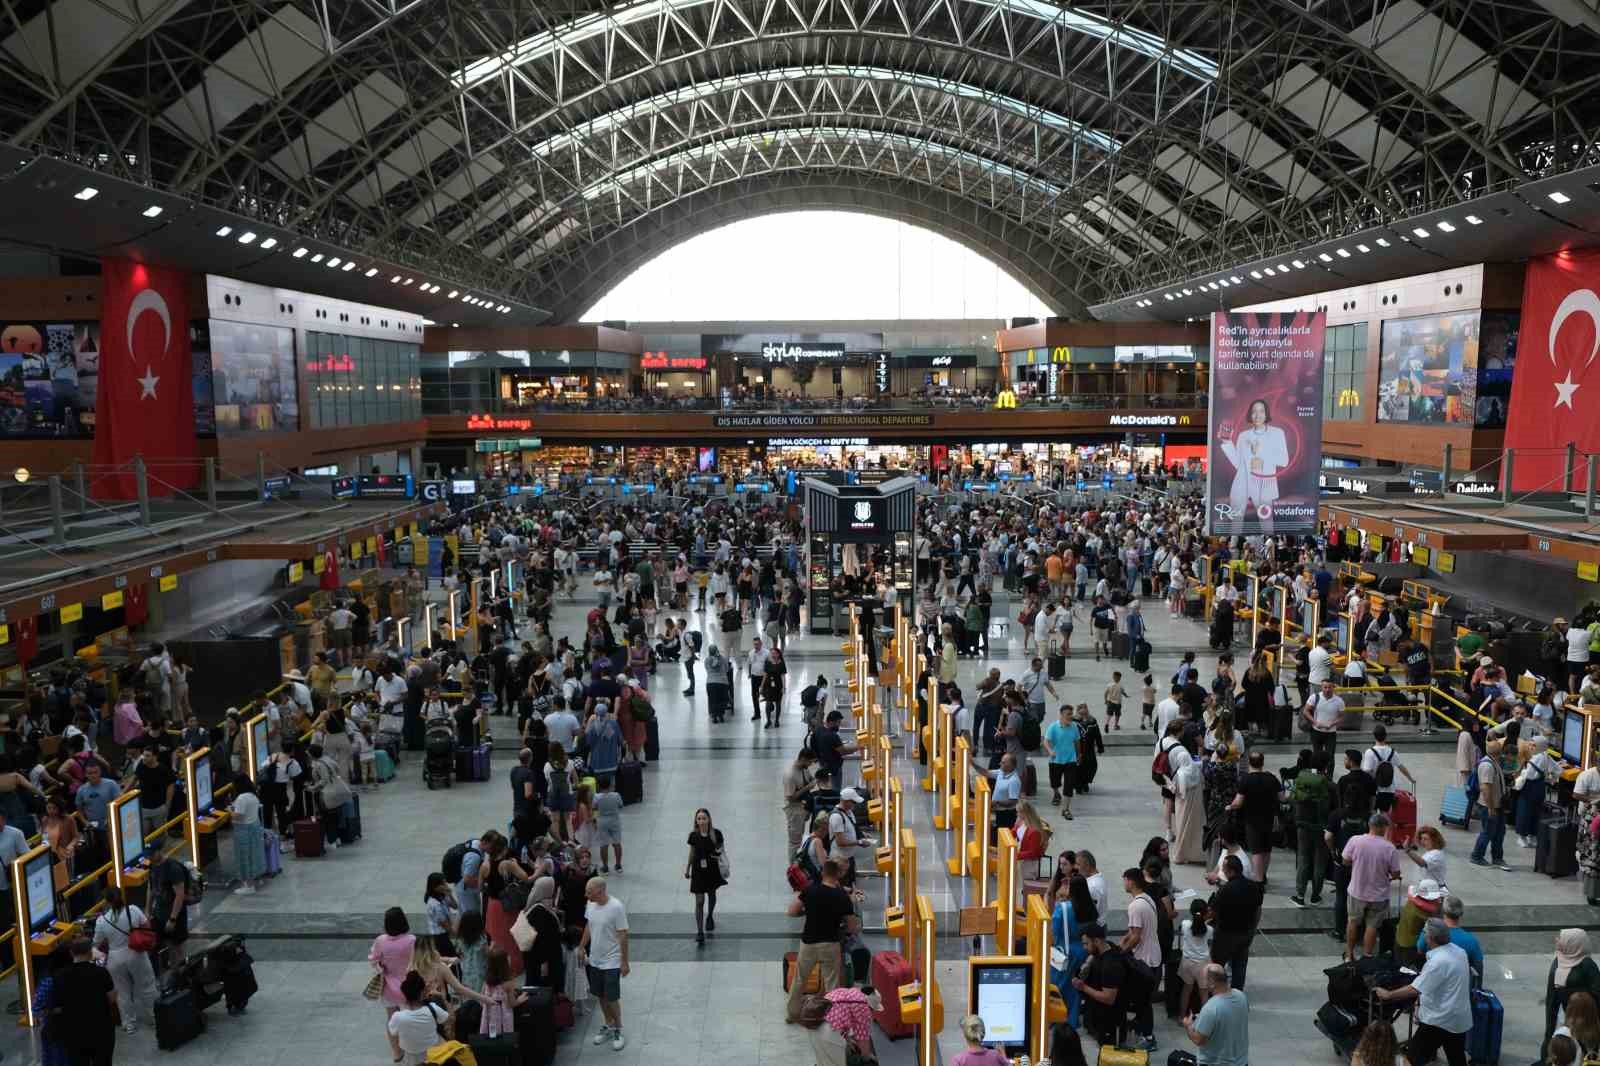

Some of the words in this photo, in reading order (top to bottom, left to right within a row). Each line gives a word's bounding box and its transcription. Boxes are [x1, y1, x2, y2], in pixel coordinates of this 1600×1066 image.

[1219, 326, 1248, 335] Red'in
[763, 341, 802, 362] SKYLAR
[1250, 350, 1269, 361] yurt
[732, 416, 761, 425] HATLAR
[789, 416, 814, 425] YOLCU
[820, 415, 880, 425] INTERNATIONAL
[882, 415, 928, 425] DEPARTURES
[1110, 415, 1177, 425] McDonald's
[424, 484, 438, 499] G
[1273, 506, 1315, 516] vodafone
